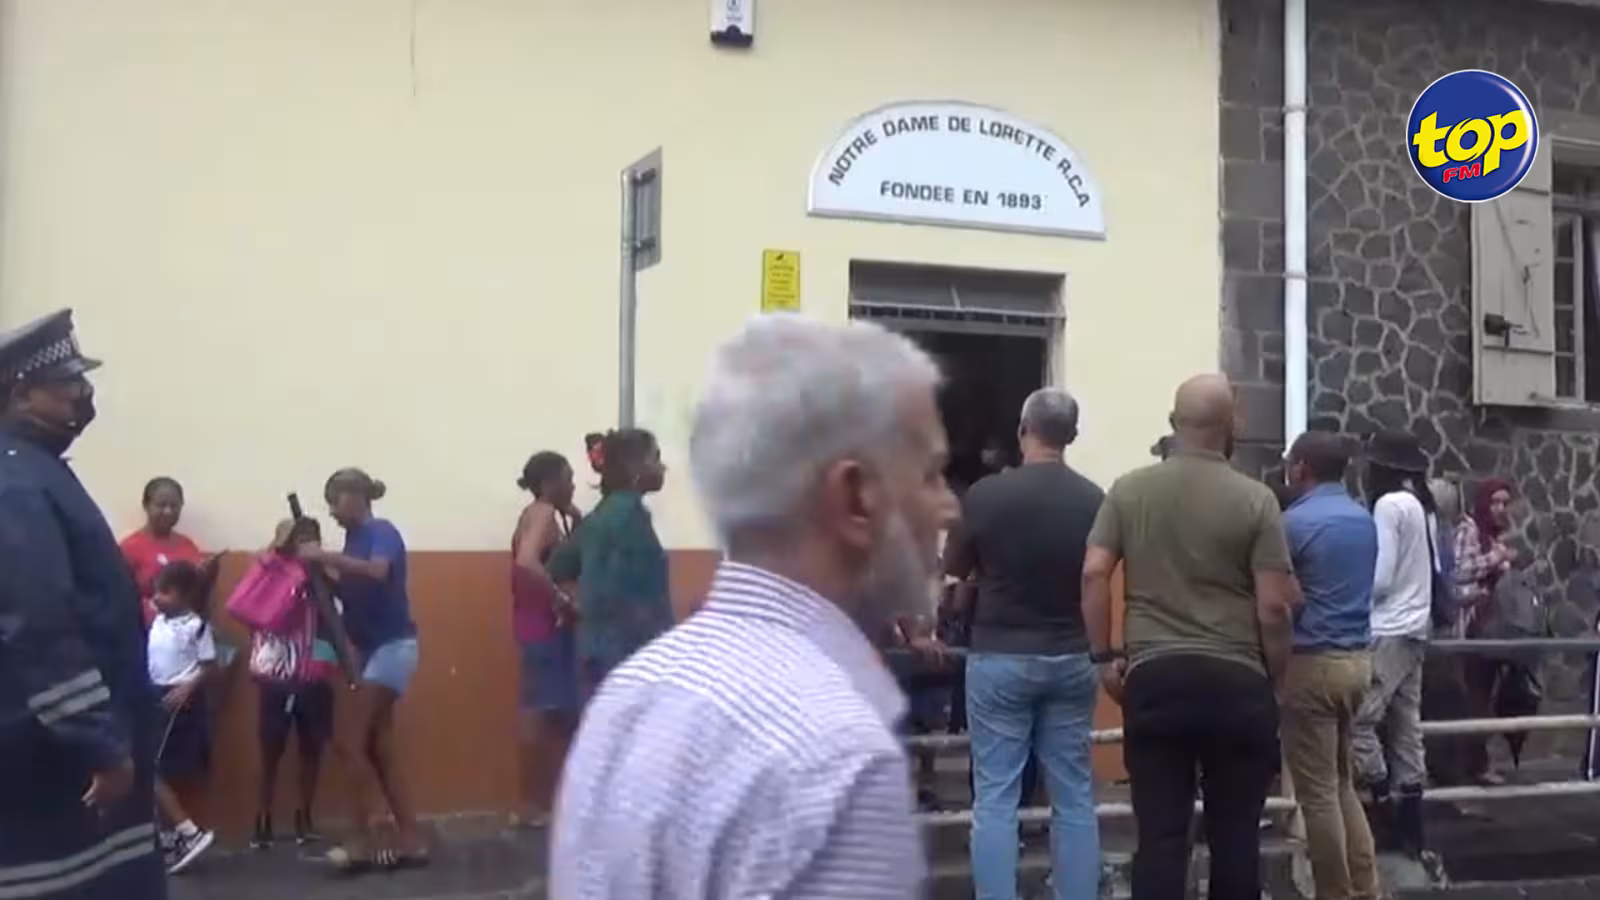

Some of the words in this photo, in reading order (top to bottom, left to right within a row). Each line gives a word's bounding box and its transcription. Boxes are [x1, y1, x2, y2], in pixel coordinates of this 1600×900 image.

[828, 129, 877, 187] NOTRE
[882, 115, 939, 137] DAME
[948, 116, 971, 132] DE
[979, 118, 1057, 161] LORETTE
[879, 180, 955, 203] FONDEE
[963, 189, 989, 206] EN
[997, 192, 1042, 210] 1893
